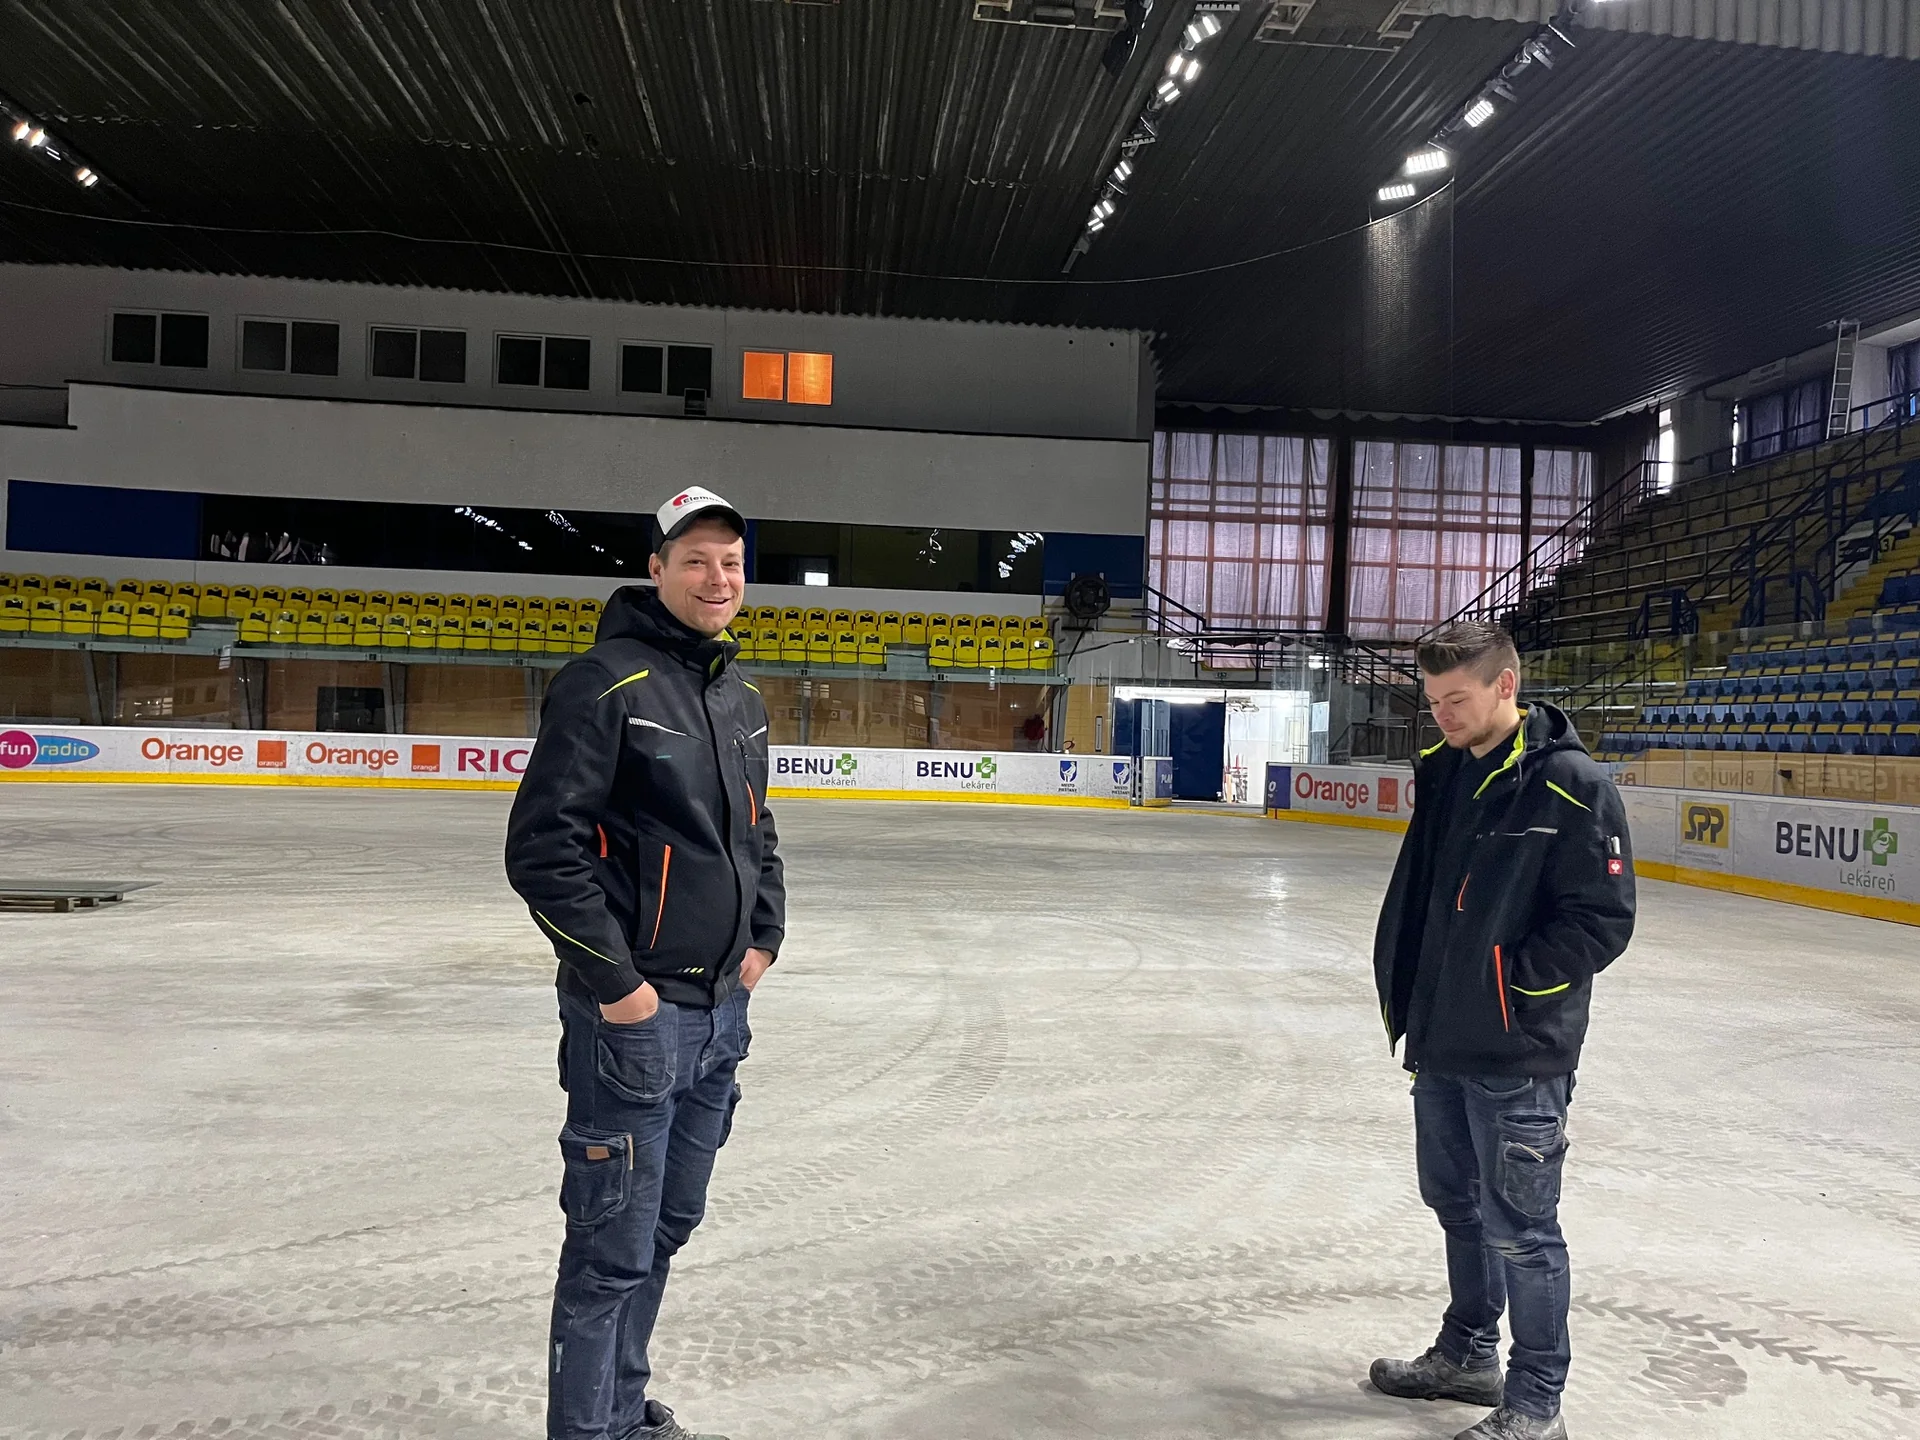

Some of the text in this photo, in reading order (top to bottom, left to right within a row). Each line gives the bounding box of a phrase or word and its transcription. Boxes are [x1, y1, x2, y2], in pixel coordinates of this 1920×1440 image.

[0, 741, 89, 756] fun radio
[141, 737, 244, 767] Orange
[306, 742, 399, 769] Orange
[258, 760, 284, 768] orange
[777, 757, 833, 775] BENU
[917, 760, 973, 778] BENU
[1295, 772, 1369, 809] Orange
[1685, 806, 1725, 843] SPP
[1776, 821, 1859, 862] BENU
[1840, 868, 1896, 893] Lekáreň
